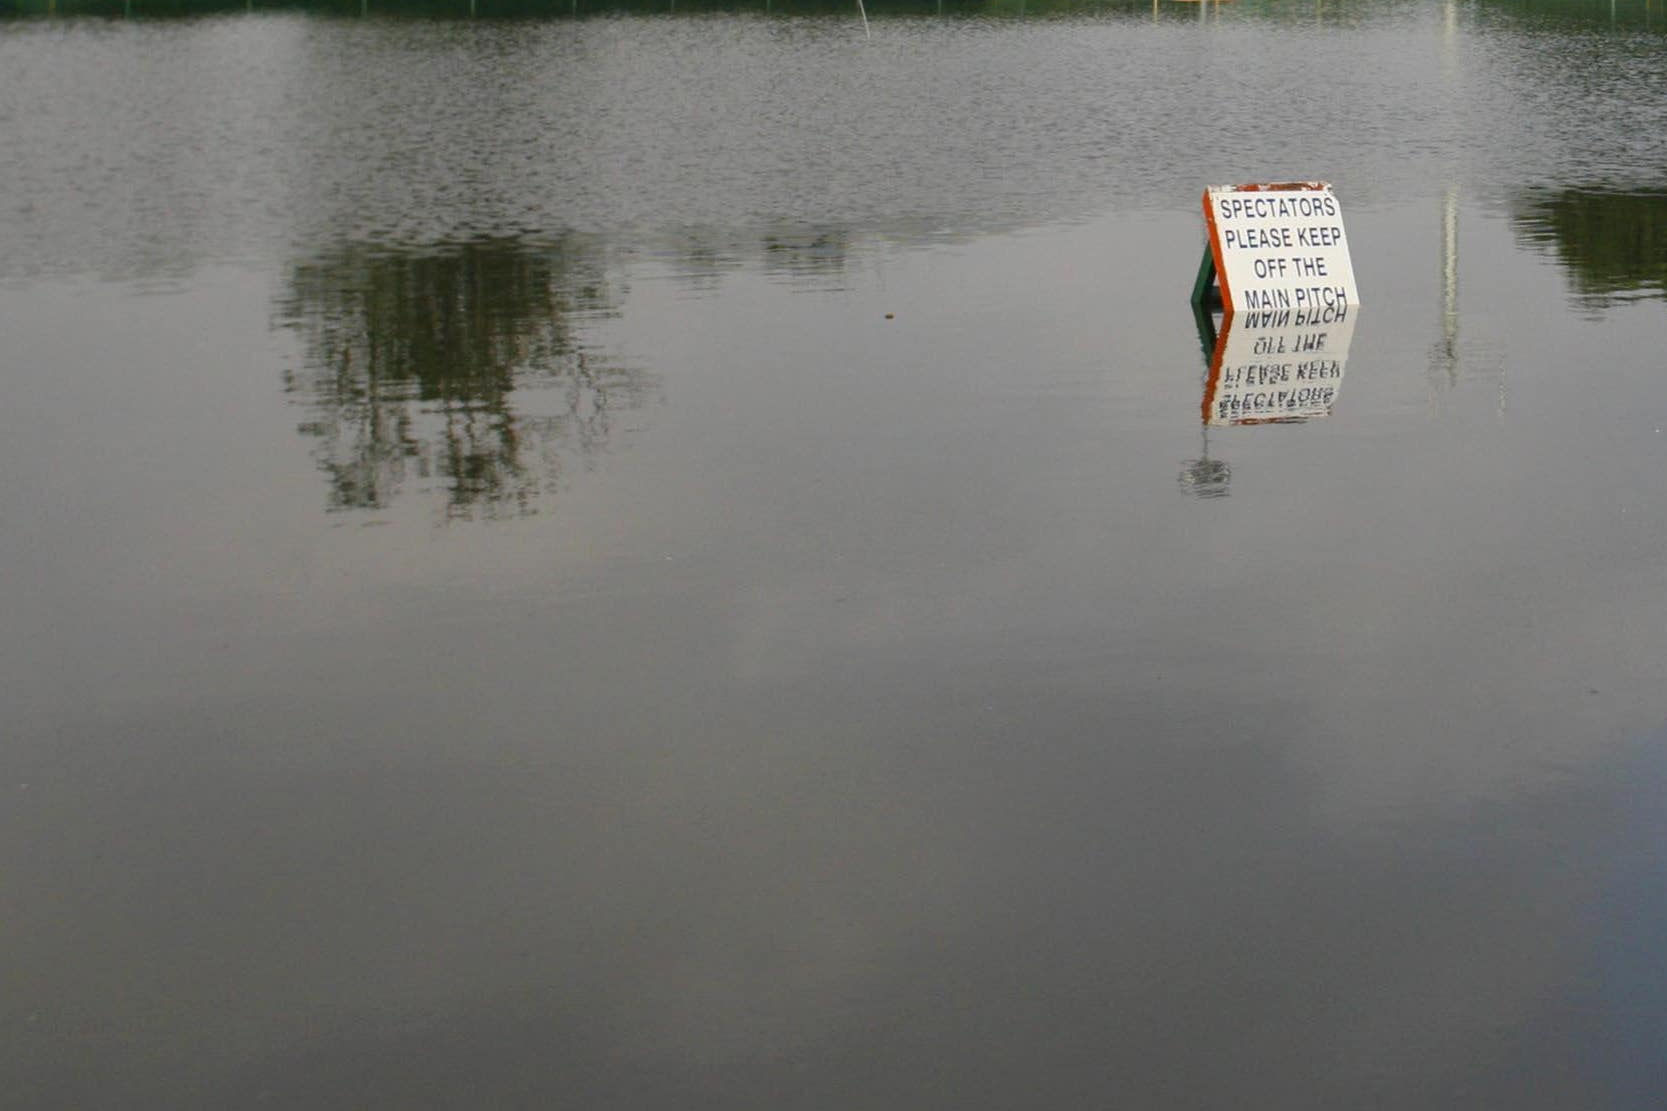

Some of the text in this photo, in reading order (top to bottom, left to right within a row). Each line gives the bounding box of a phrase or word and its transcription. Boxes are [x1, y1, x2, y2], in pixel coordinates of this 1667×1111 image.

[1220, 197, 1336, 219] SPECTATORS
[1225, 227, 1341, 249] PLEASE KEEP
[1254, 257, 1328, 278] OFF THE
[1245, 287, 1347, 309] MAIN PITCH
